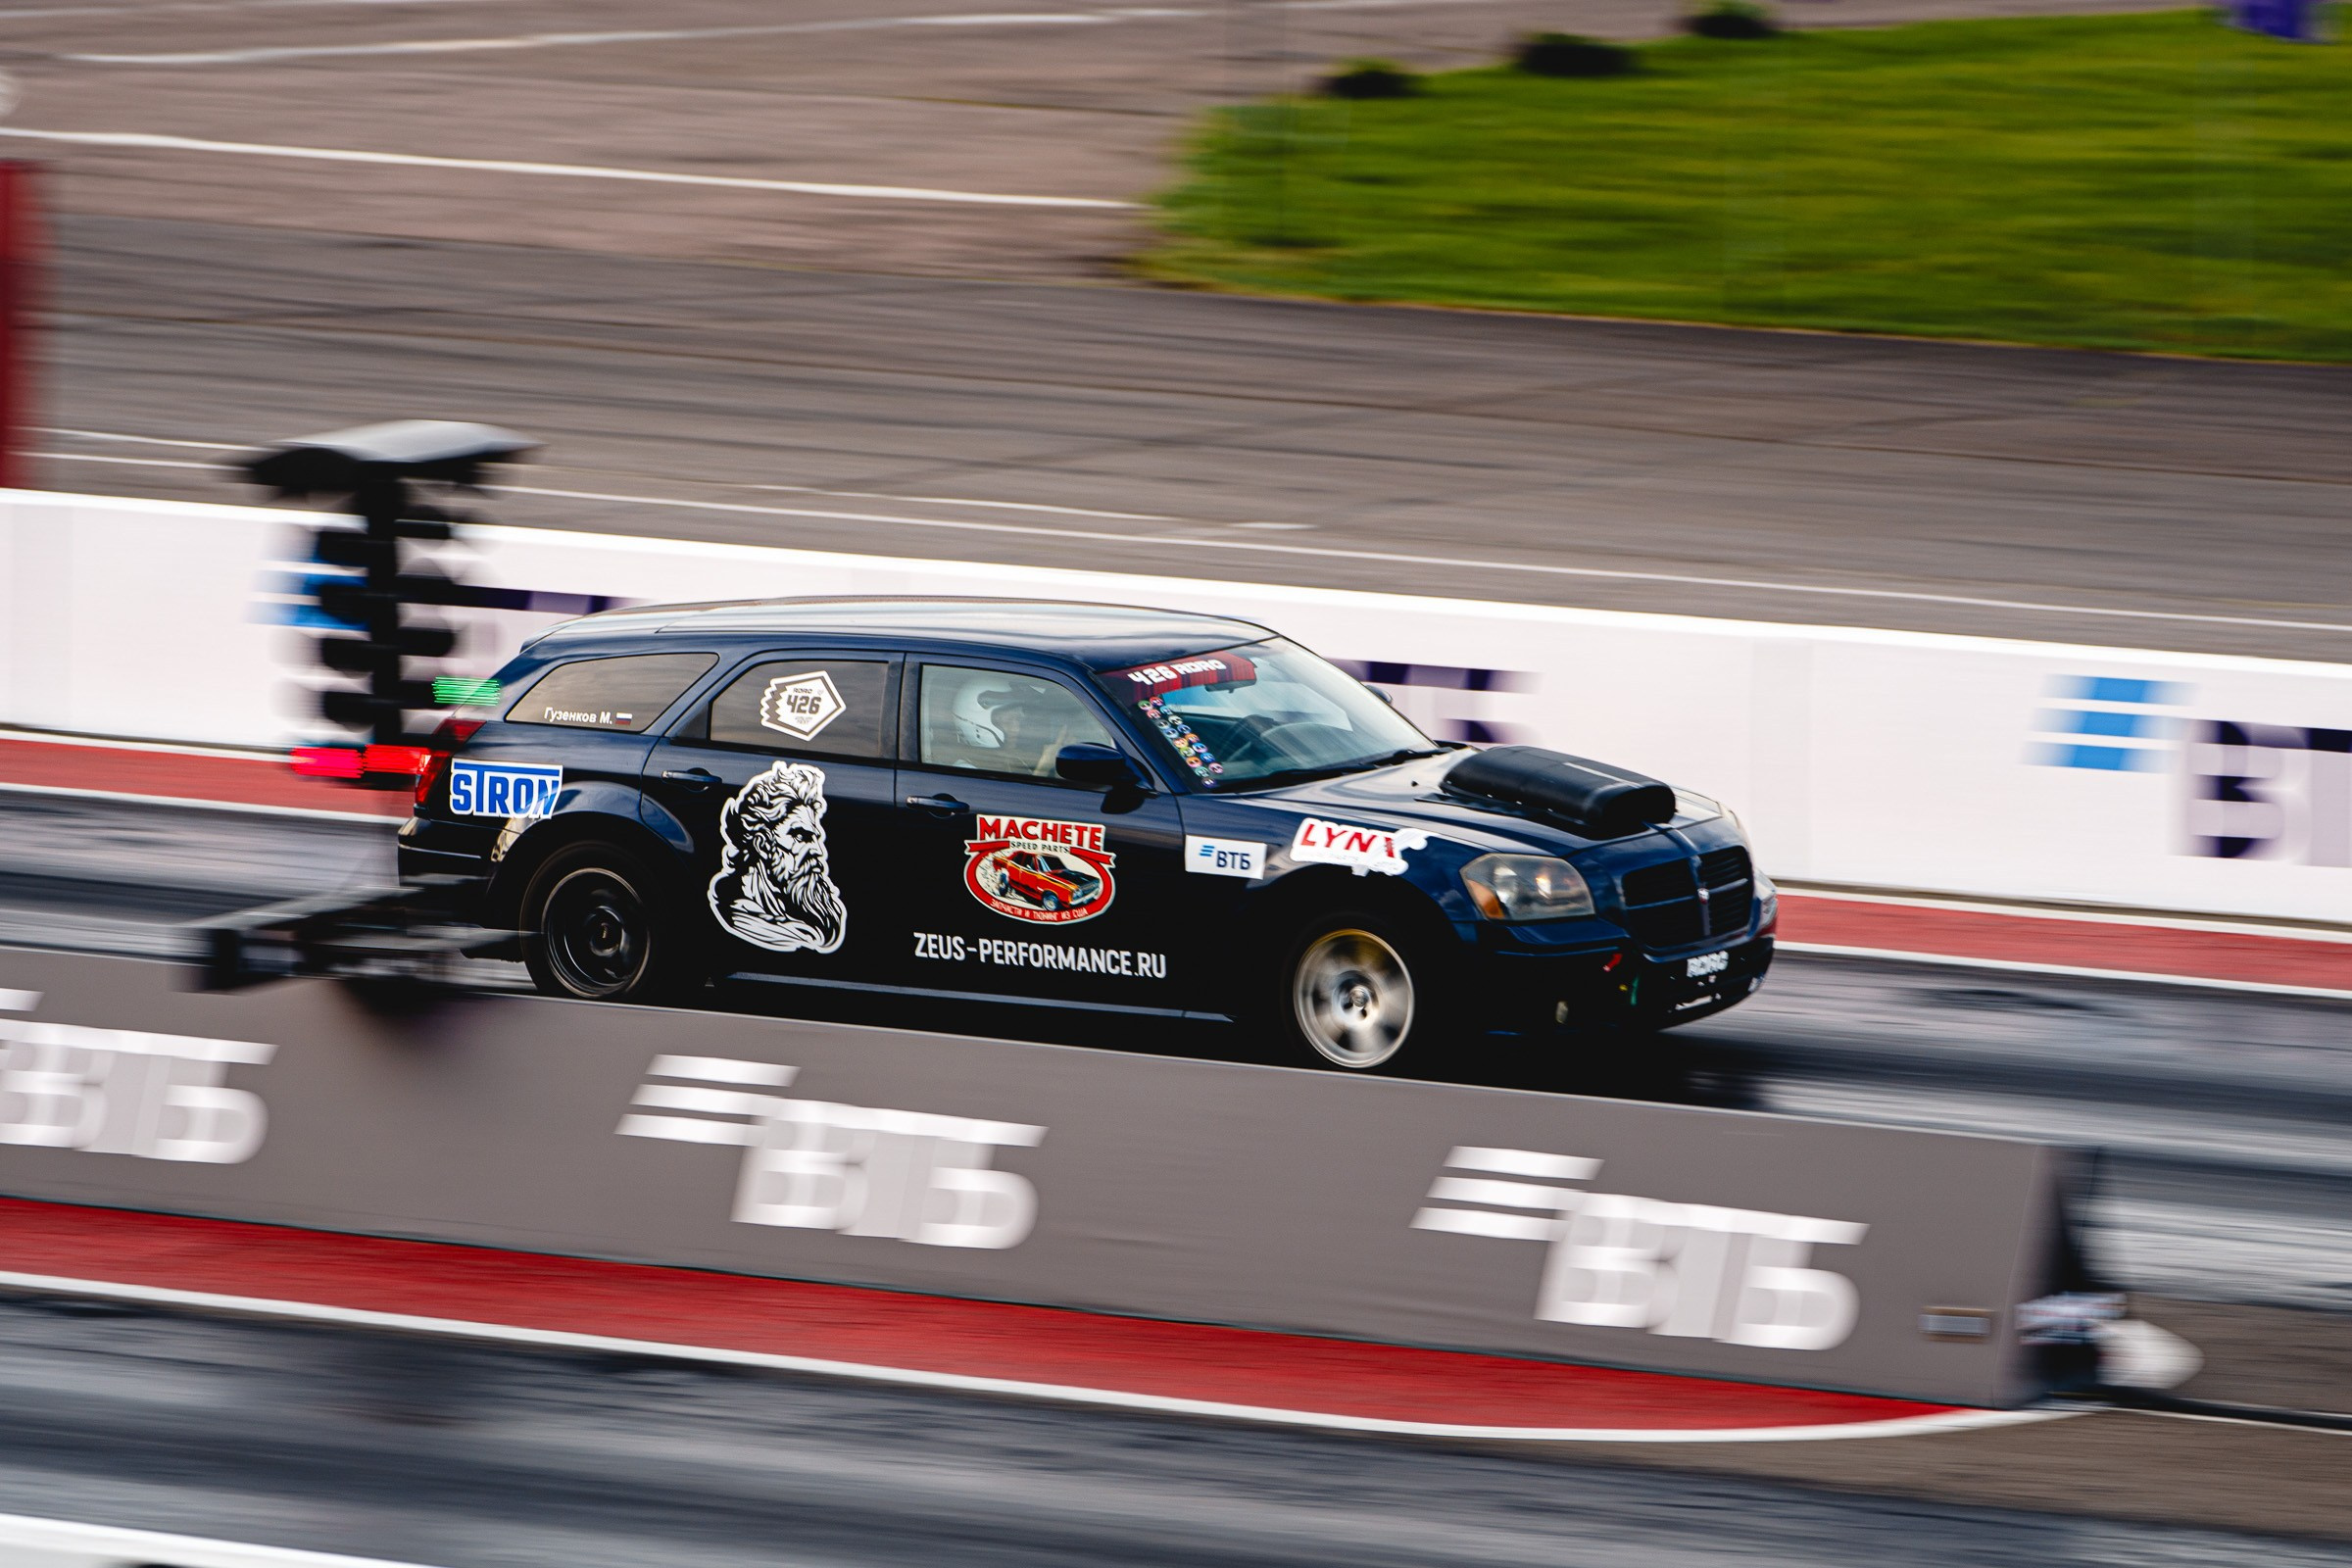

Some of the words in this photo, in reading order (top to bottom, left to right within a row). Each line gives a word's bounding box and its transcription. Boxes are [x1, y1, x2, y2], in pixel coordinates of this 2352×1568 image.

[1127, 665, 1177, 685] 426
[786, 694, 822, 715] 426
[544, 707, 597, 723] Гузенков
[599, 711, 612, 724] М.
[453, 761, 560, 815] STRON
[979, 816, 1102, 852] MACHETE
[1010, 841, 1038, 850] SPEED
[1042, 844, 1069, 854] PARTS
[1216, 850, 1251, 871] ВТБ
[913, 932, 1167, 979] ZEUS-PERFORMANCE.RU
